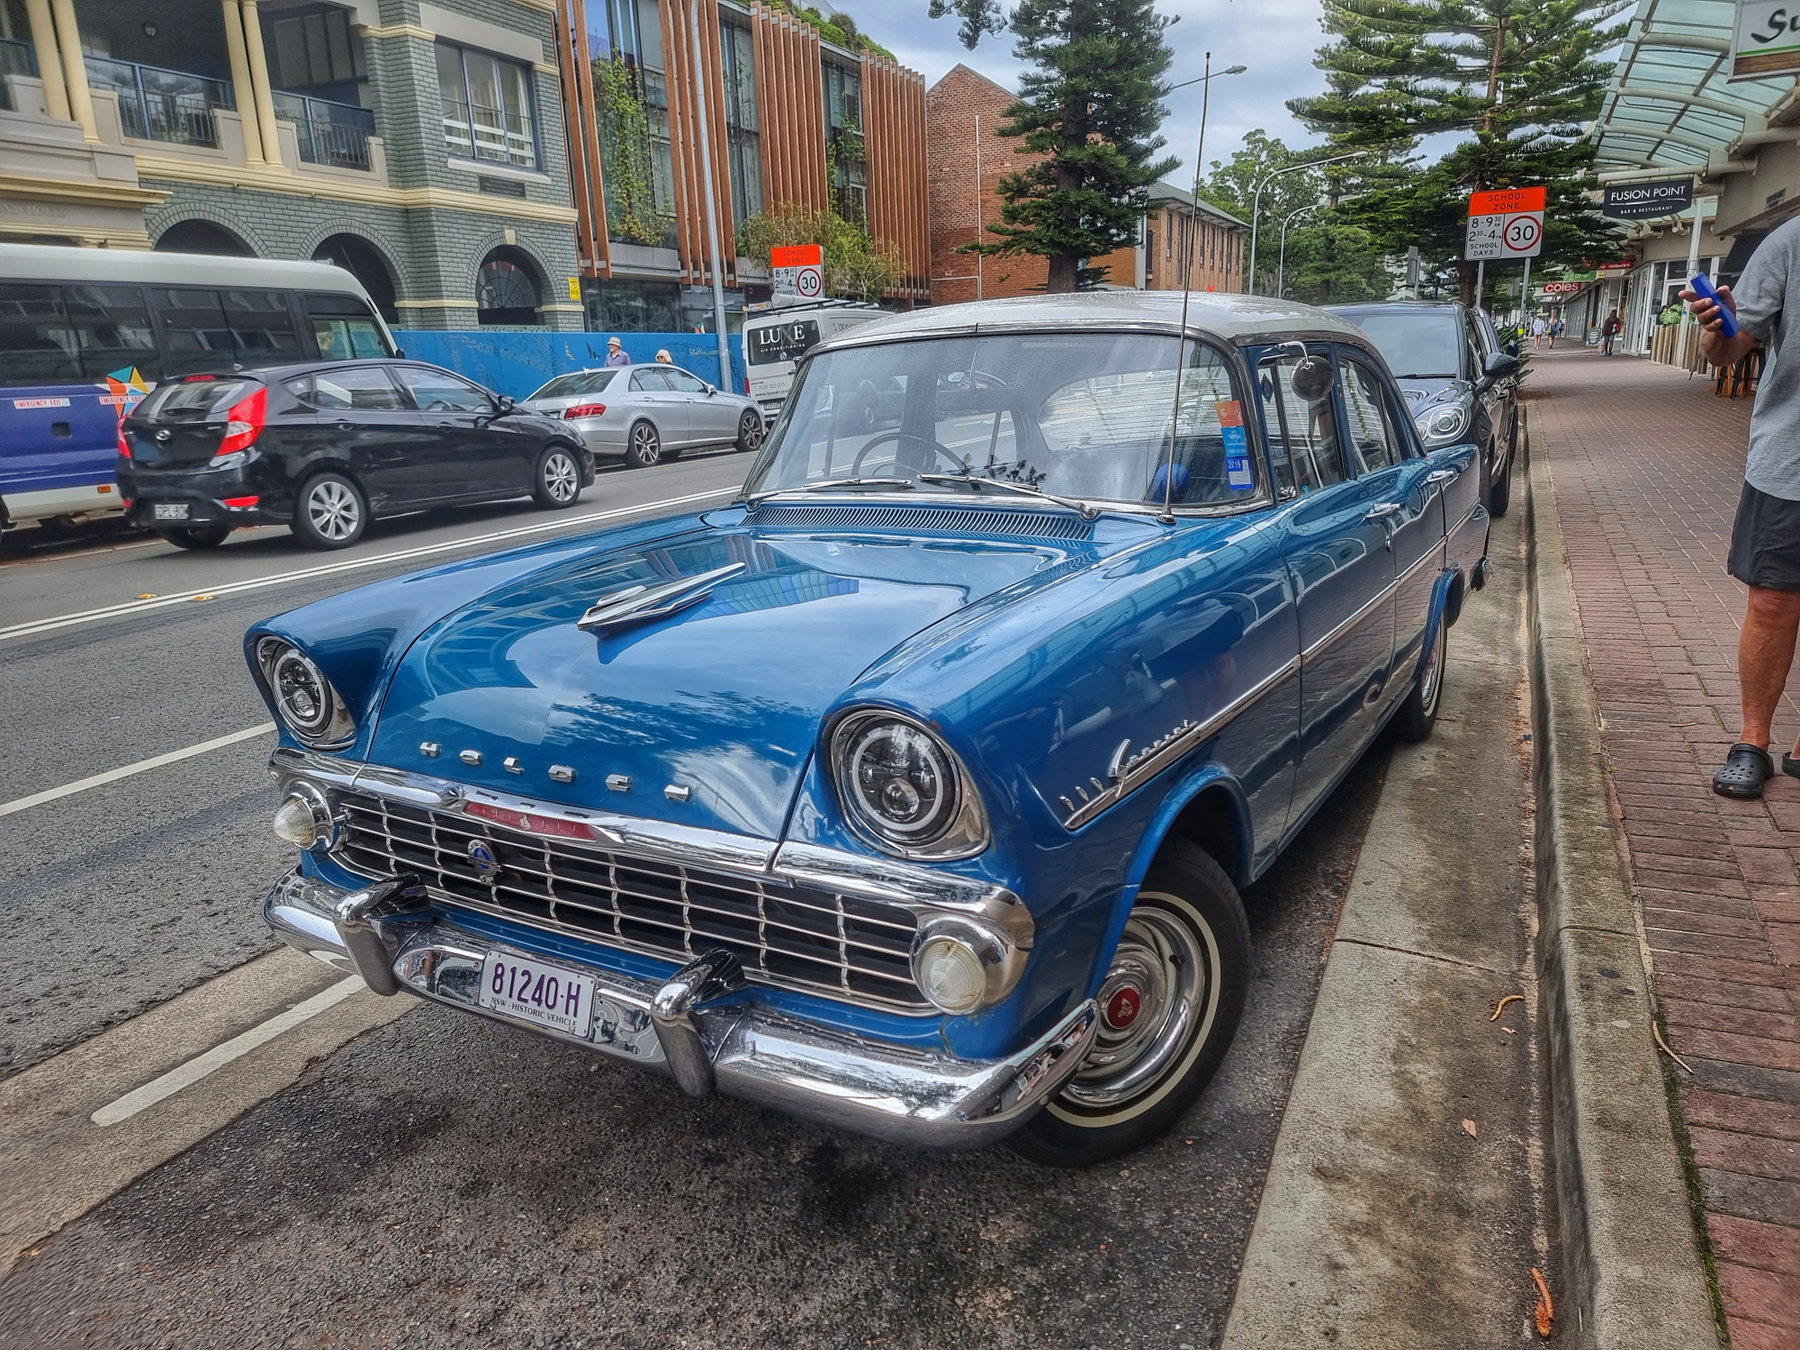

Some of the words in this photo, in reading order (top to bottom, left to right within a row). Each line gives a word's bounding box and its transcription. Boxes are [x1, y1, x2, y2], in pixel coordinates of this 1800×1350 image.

[1488, 192, 1527, 202] SCHOOL
[1611, 188, 1650, 202] FUSION
[1653, 185, 1686, 197] POINT
[1493, 202, 1520, 211] ZONE
[1638, 205, 1673, 213] RESTAURANT
[1510, 225, 1534, 242] 30
[1470, 242, 1499, 250] SCHOOL
[801, 276, 817, 290] 30
[1545, 282, 1579, 293] coles
[759, 322, 806, 345] LUXE
[15, 400, 47, 408] EMERGENCY
[101, 395, 131, 404] EMERGENCY
[1228, 460, 1241, 469] 2019
[419, 741, 692, 802] HOLDEN
[490, 996, 507, 1007] NSW
[511, 1002, 546, 1018] HISTORIC
[546, 1012, 577, 1027] VEHICLE
